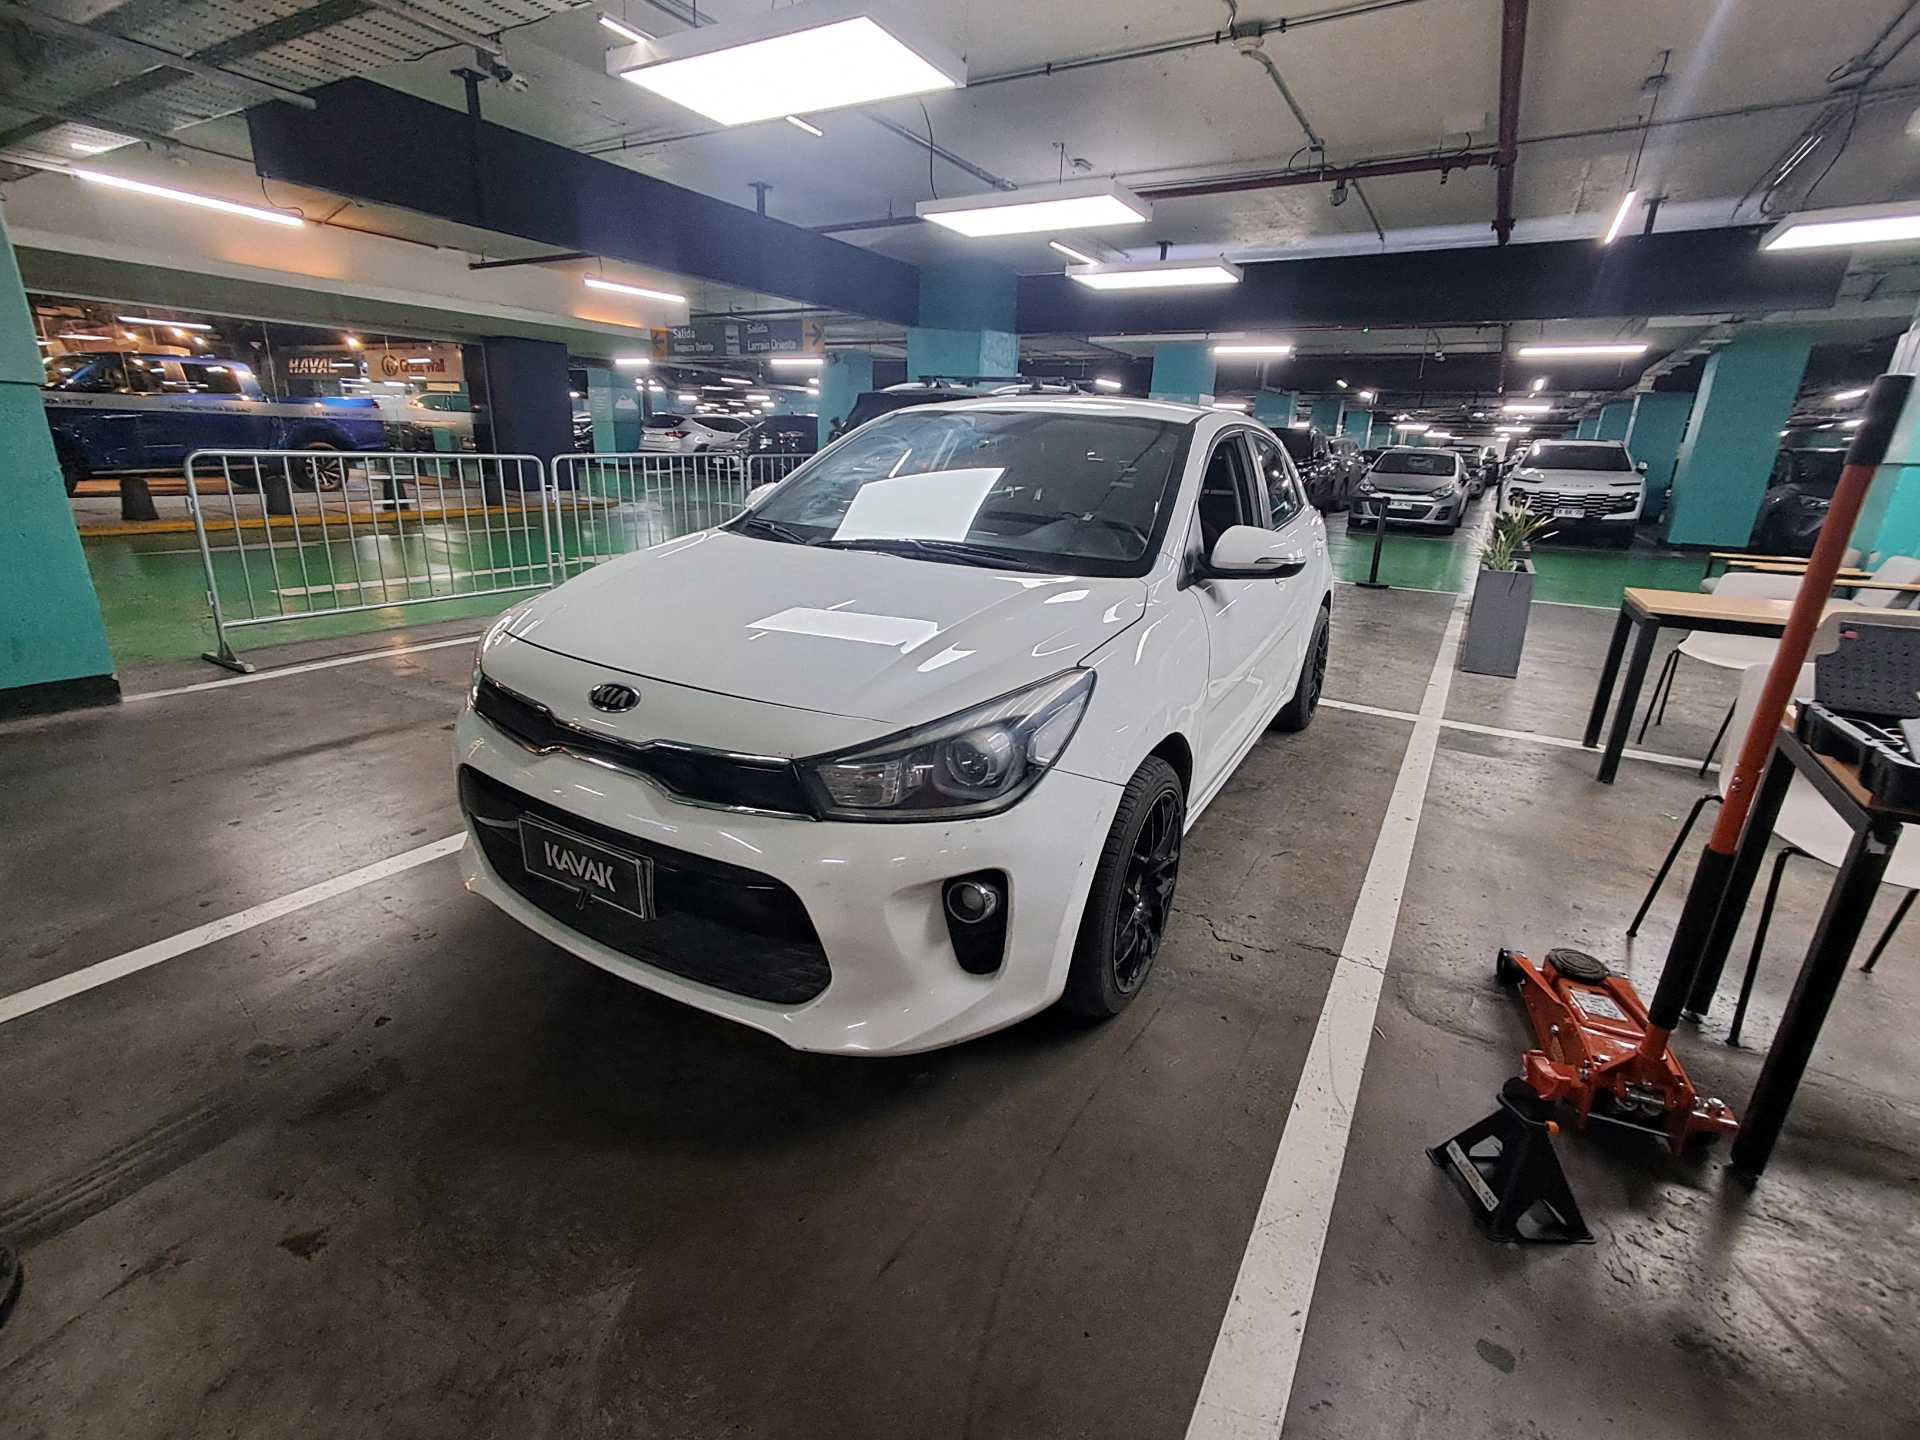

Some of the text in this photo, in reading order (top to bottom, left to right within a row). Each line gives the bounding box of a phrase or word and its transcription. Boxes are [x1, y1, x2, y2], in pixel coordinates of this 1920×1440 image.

[672, 328, 696, 338] Salida
[288, 358, 338, 374] HAVAL
[593, 686, 630, 708] KIA
[543, 840, 616, 893] KAVAK
